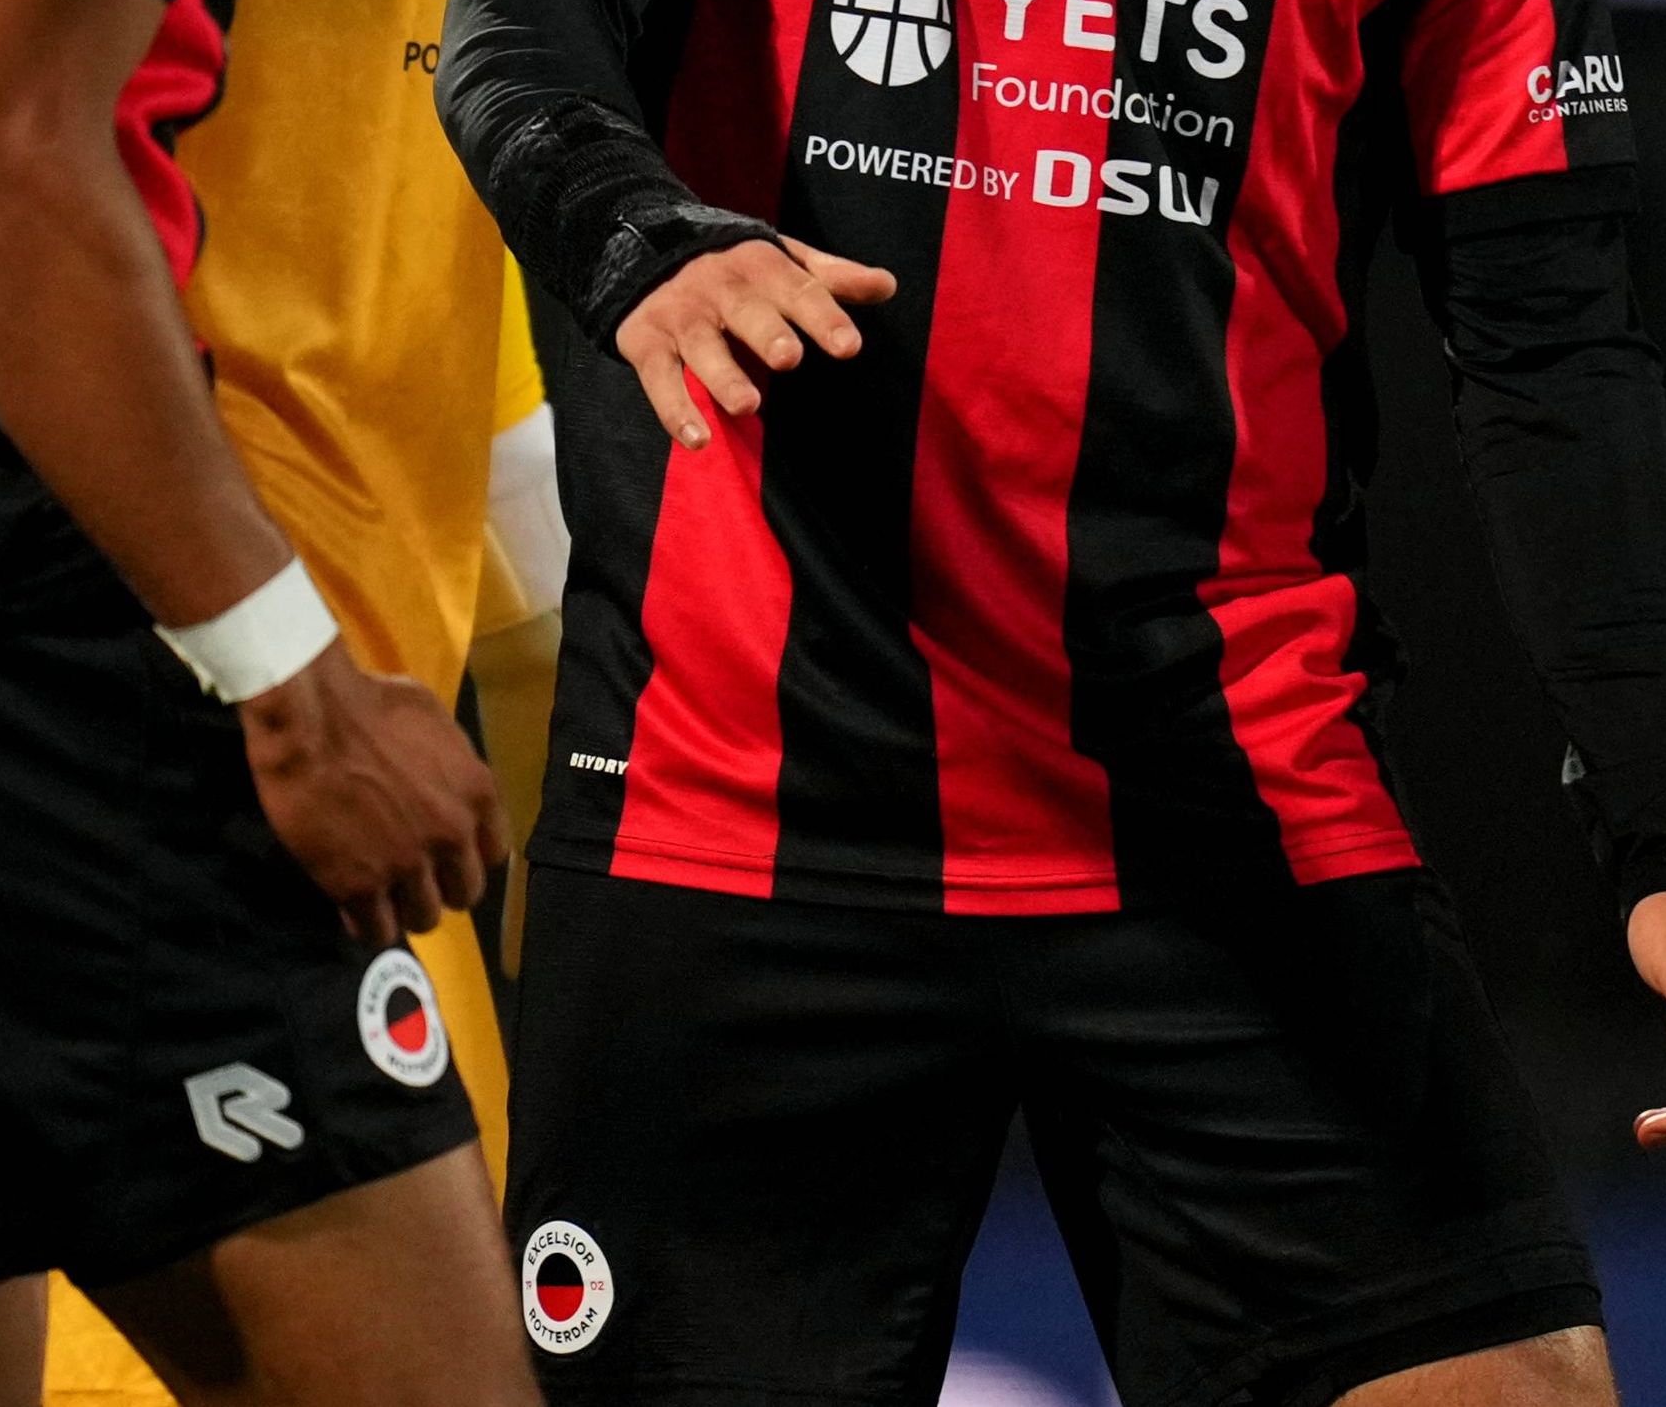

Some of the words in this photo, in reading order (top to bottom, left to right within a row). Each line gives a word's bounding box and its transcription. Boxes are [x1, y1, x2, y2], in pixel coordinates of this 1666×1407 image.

[1526, 54, 1625, 105] CARU
[971, 61, 1235, 148] Foundation
[1528, 97, 1629, 124] CONTAINERS
[804, 135, 978, 190] POWERED
[982, 165, 1020, 201] BY
[1032, 149, 1220, 227] DSW
[569, 752, 629, 775] BEYDRY
[528, 1231, 595, 1267] EXCELSIOR
[529, 1307, 598, 1343] ROTTERDAM
